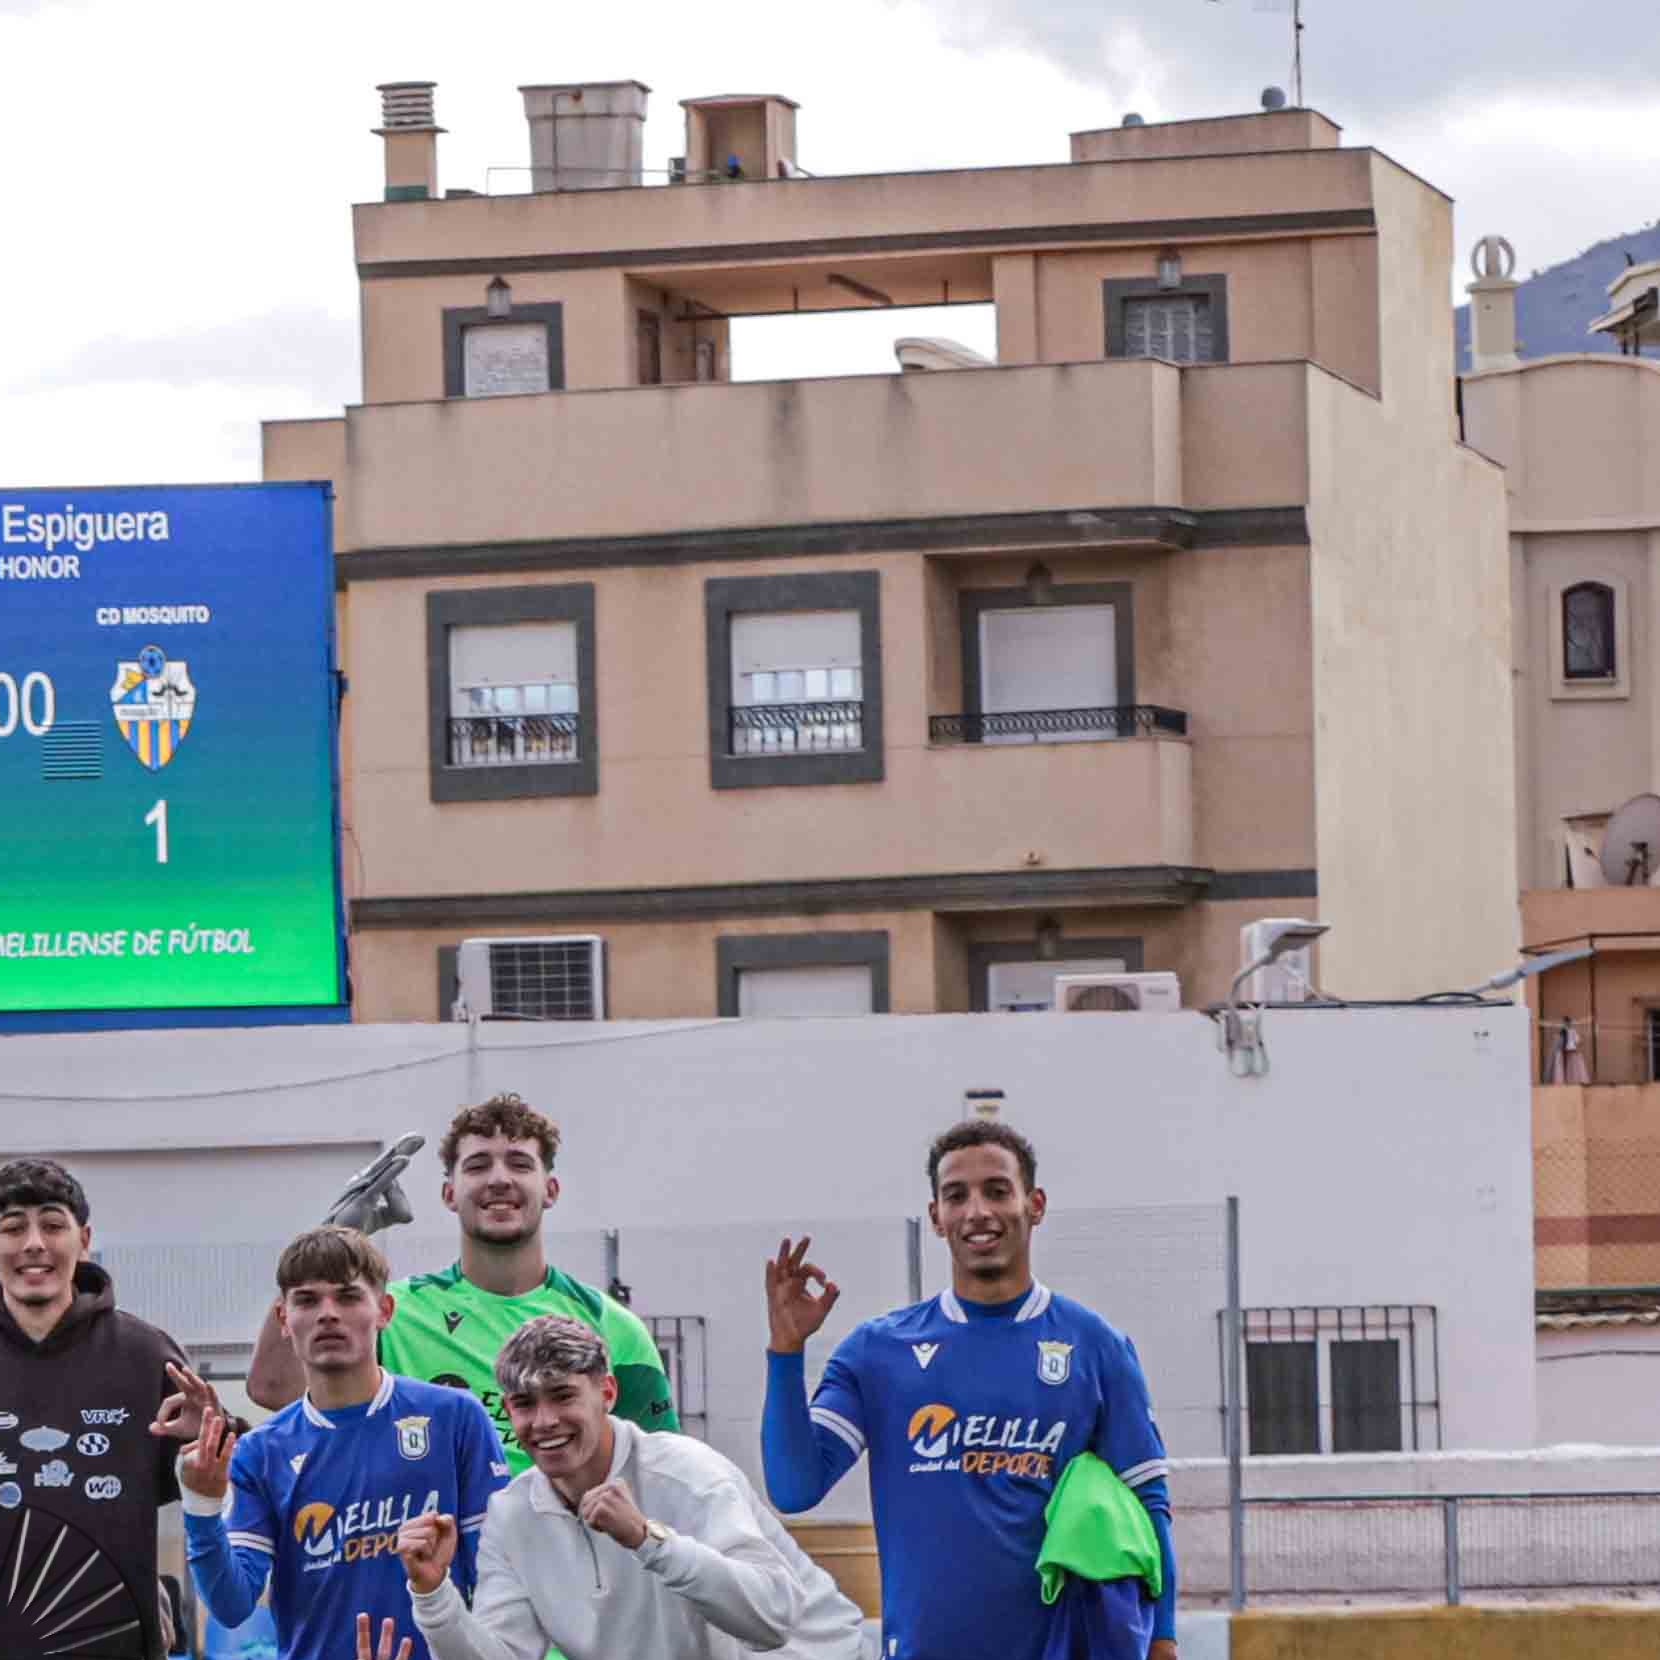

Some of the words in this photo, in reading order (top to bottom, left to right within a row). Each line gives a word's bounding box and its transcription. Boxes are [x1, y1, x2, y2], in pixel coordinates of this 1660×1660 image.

[2, 503, 170, 552] Espiguera
[96, 607, 121, 625] CD
[123, 605, 210, 625] MOSQUITO
[144, 799, 169, 864] 1
[132, 928, 164, 957] DE
[167, 922, 257, 955] FÚTBOL
[344, 1531, 400, 1563] DEPO
